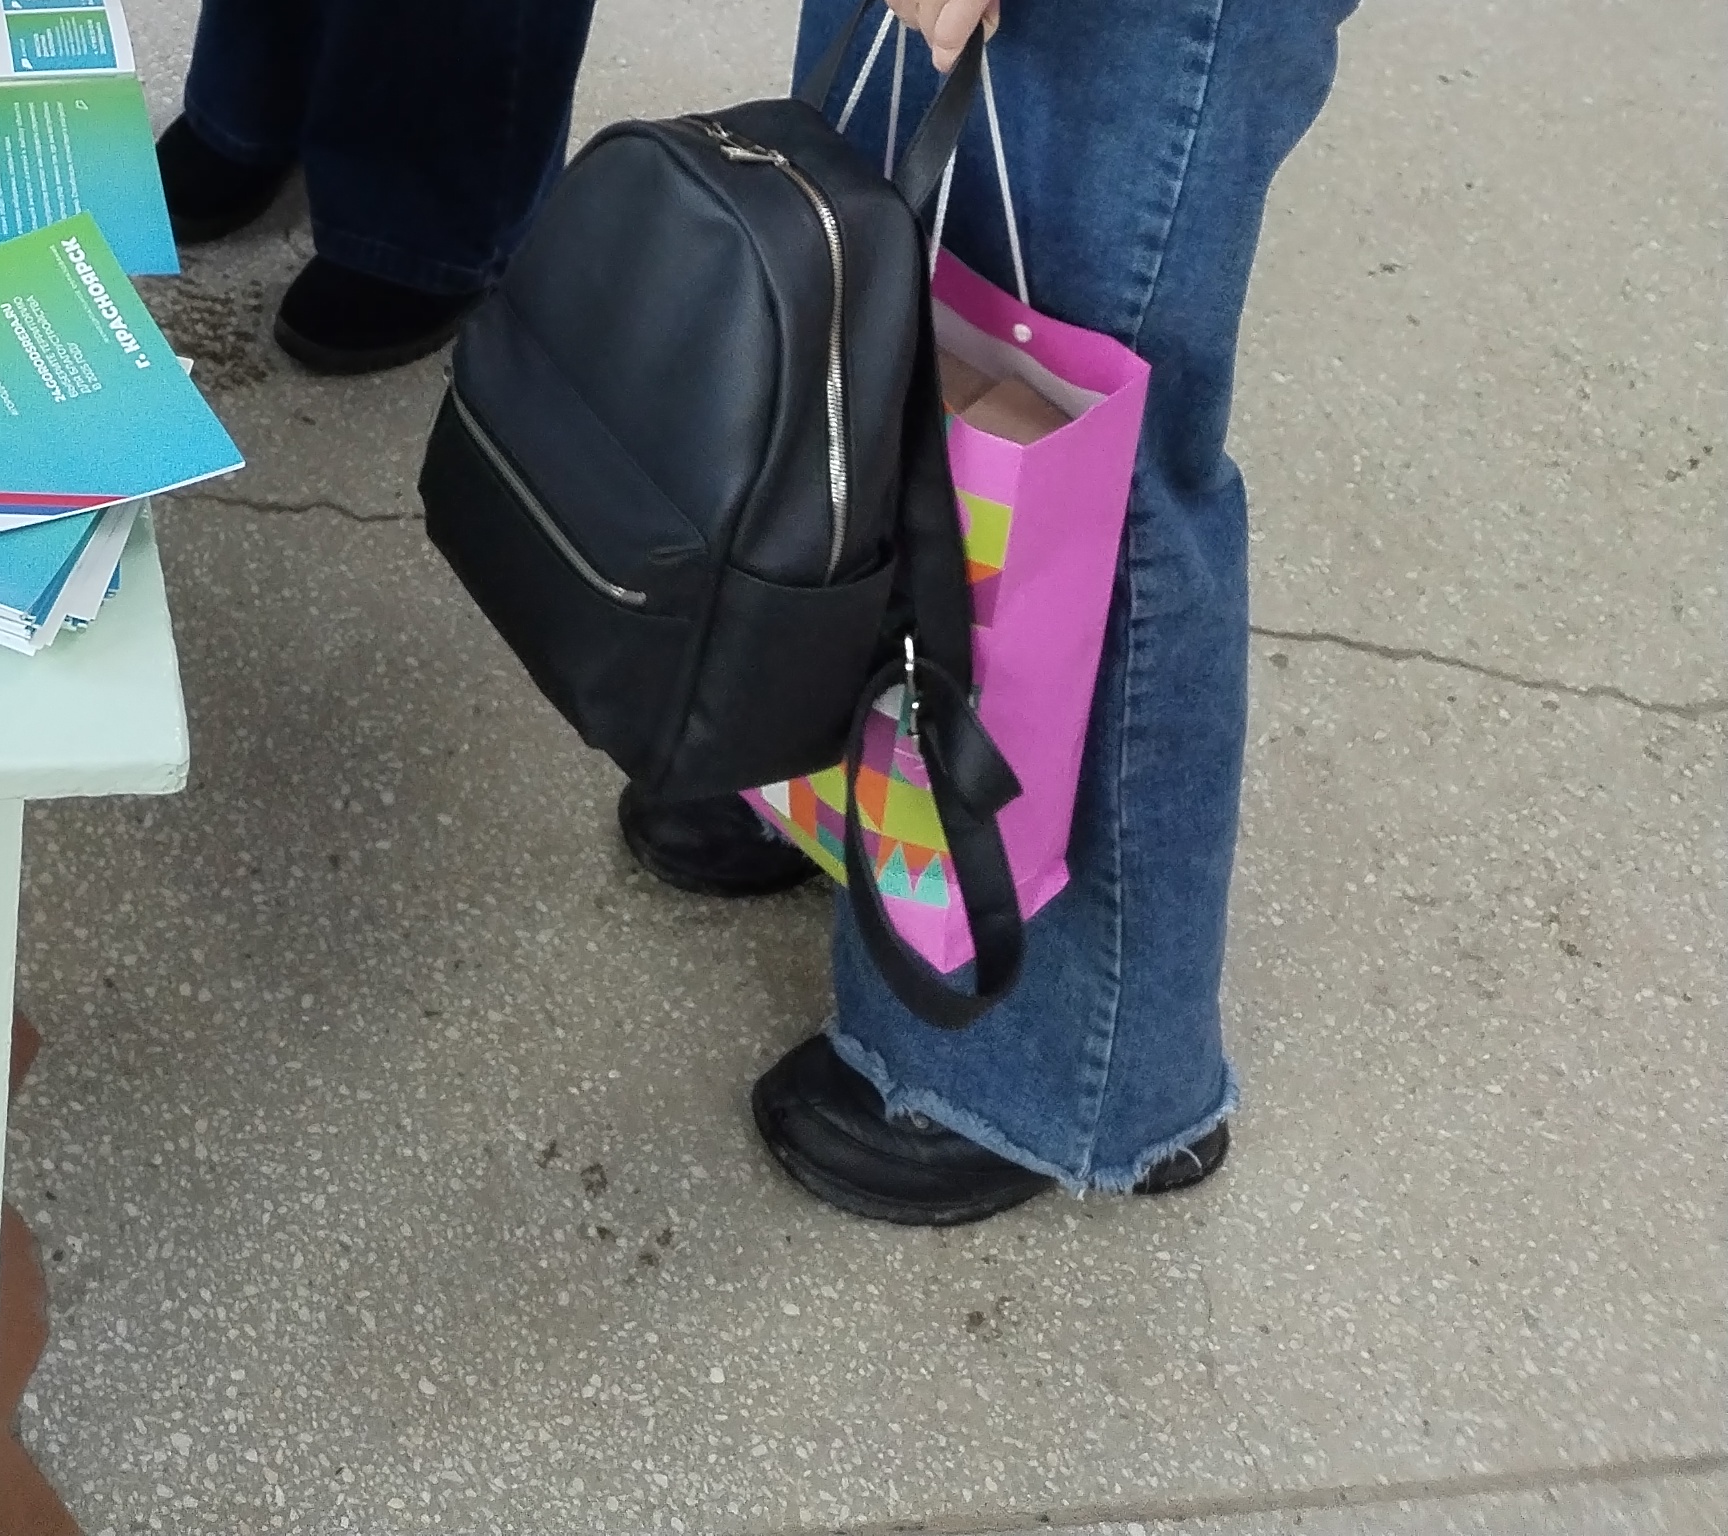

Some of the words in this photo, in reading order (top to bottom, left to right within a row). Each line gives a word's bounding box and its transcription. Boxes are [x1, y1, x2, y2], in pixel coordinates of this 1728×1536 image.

[59, 234, 142, 354] КРАСНОЯРСК
[131, 351, 152, 370] г.
[71, 373, 93, 395] ДЛЯ
